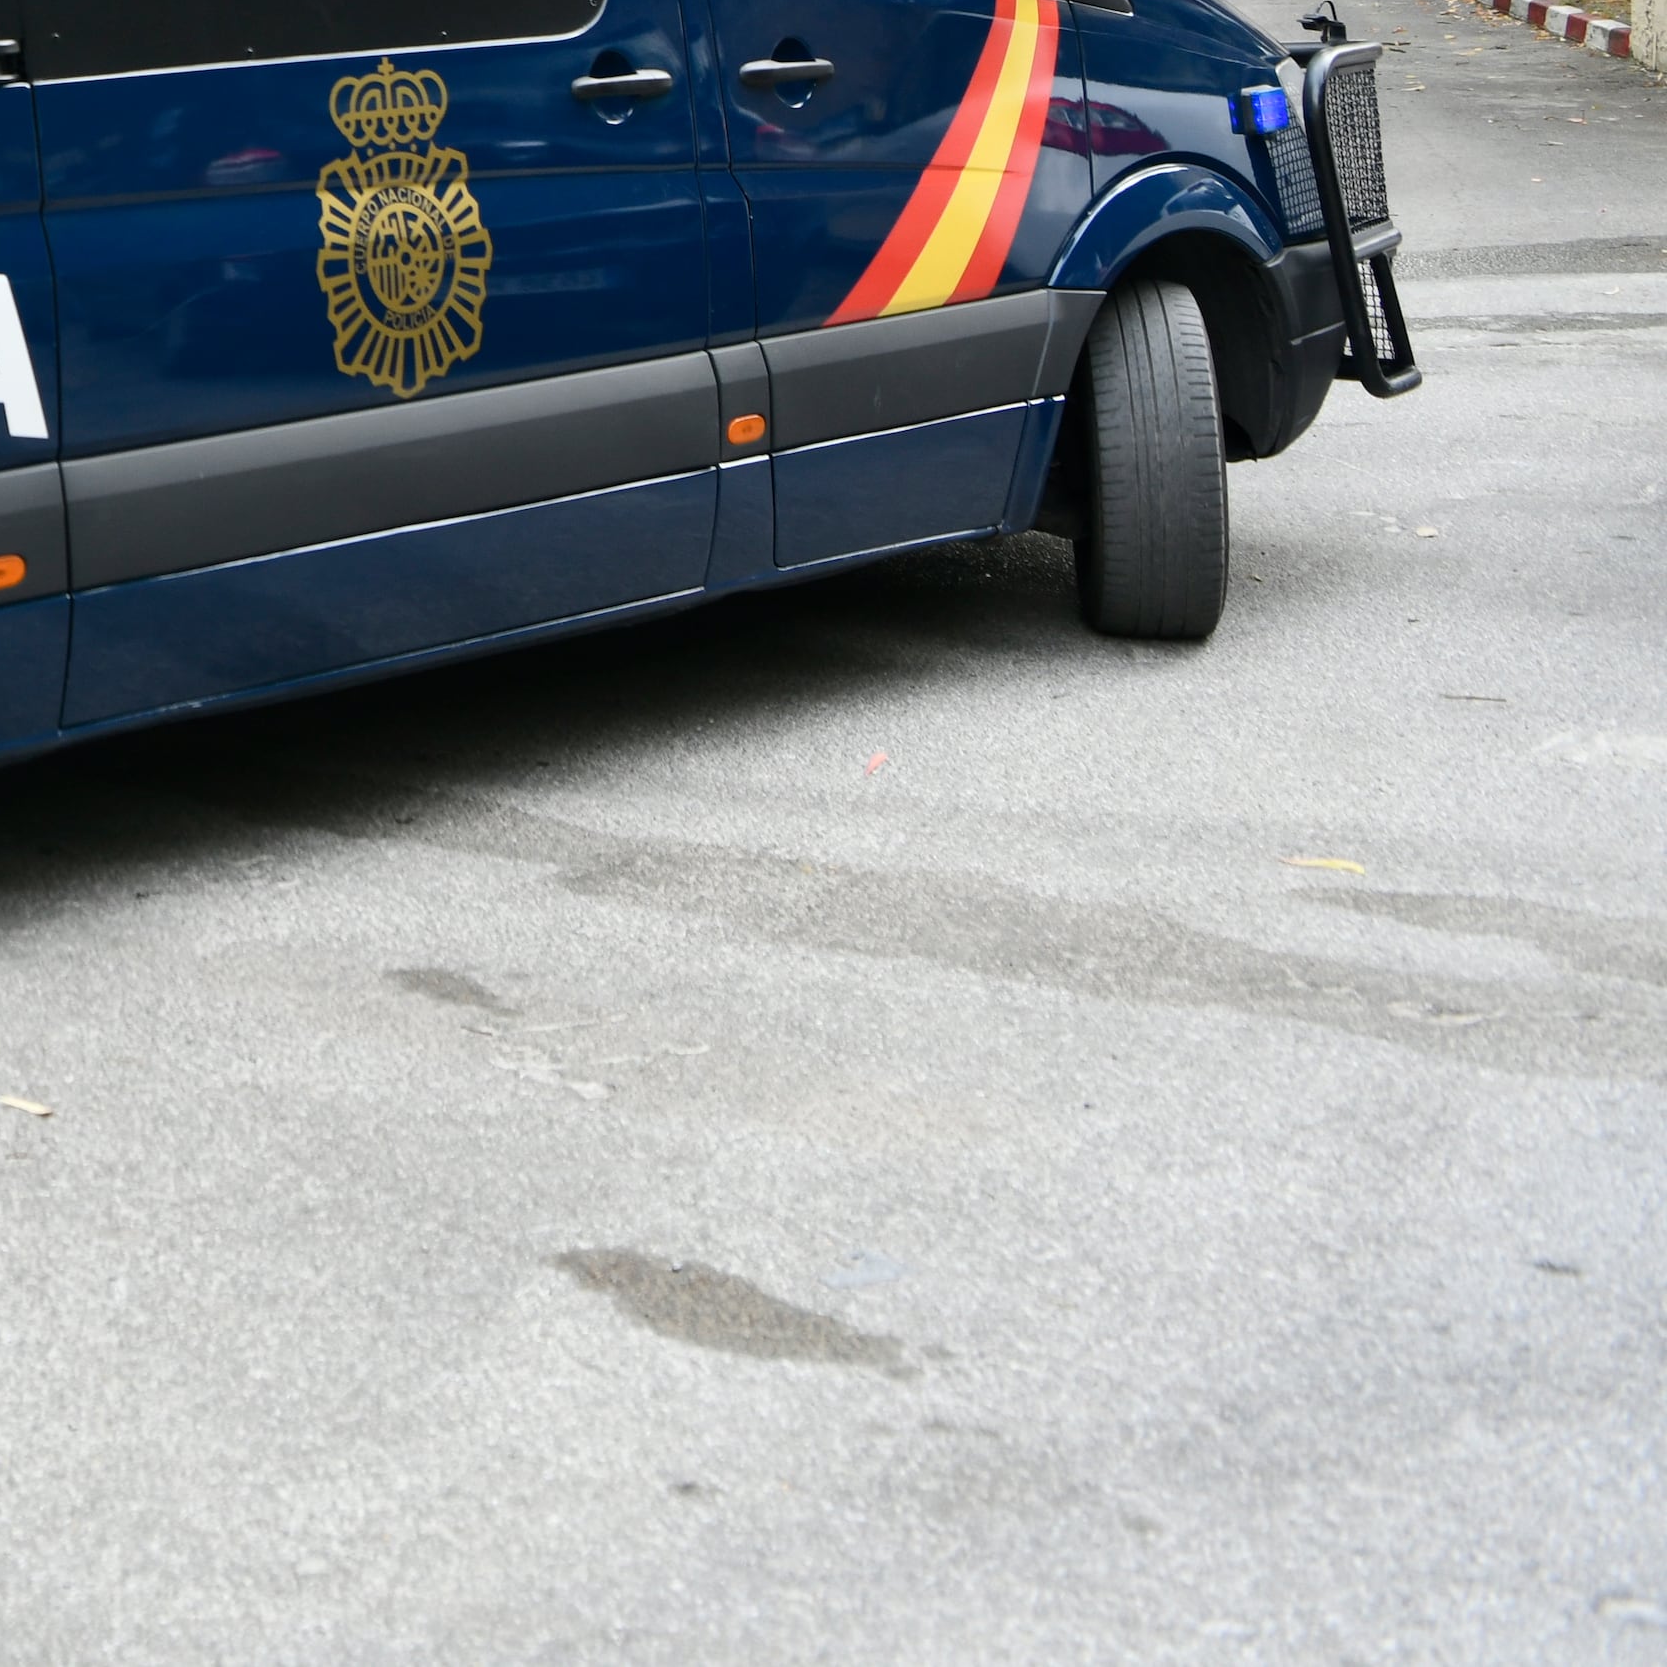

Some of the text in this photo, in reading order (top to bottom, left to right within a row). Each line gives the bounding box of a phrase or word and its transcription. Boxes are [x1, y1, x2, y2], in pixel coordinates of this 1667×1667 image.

[354, 187, 455, 274] CUERPO NACIONAL DE
[384, 305, 437, 330] POLICIA
